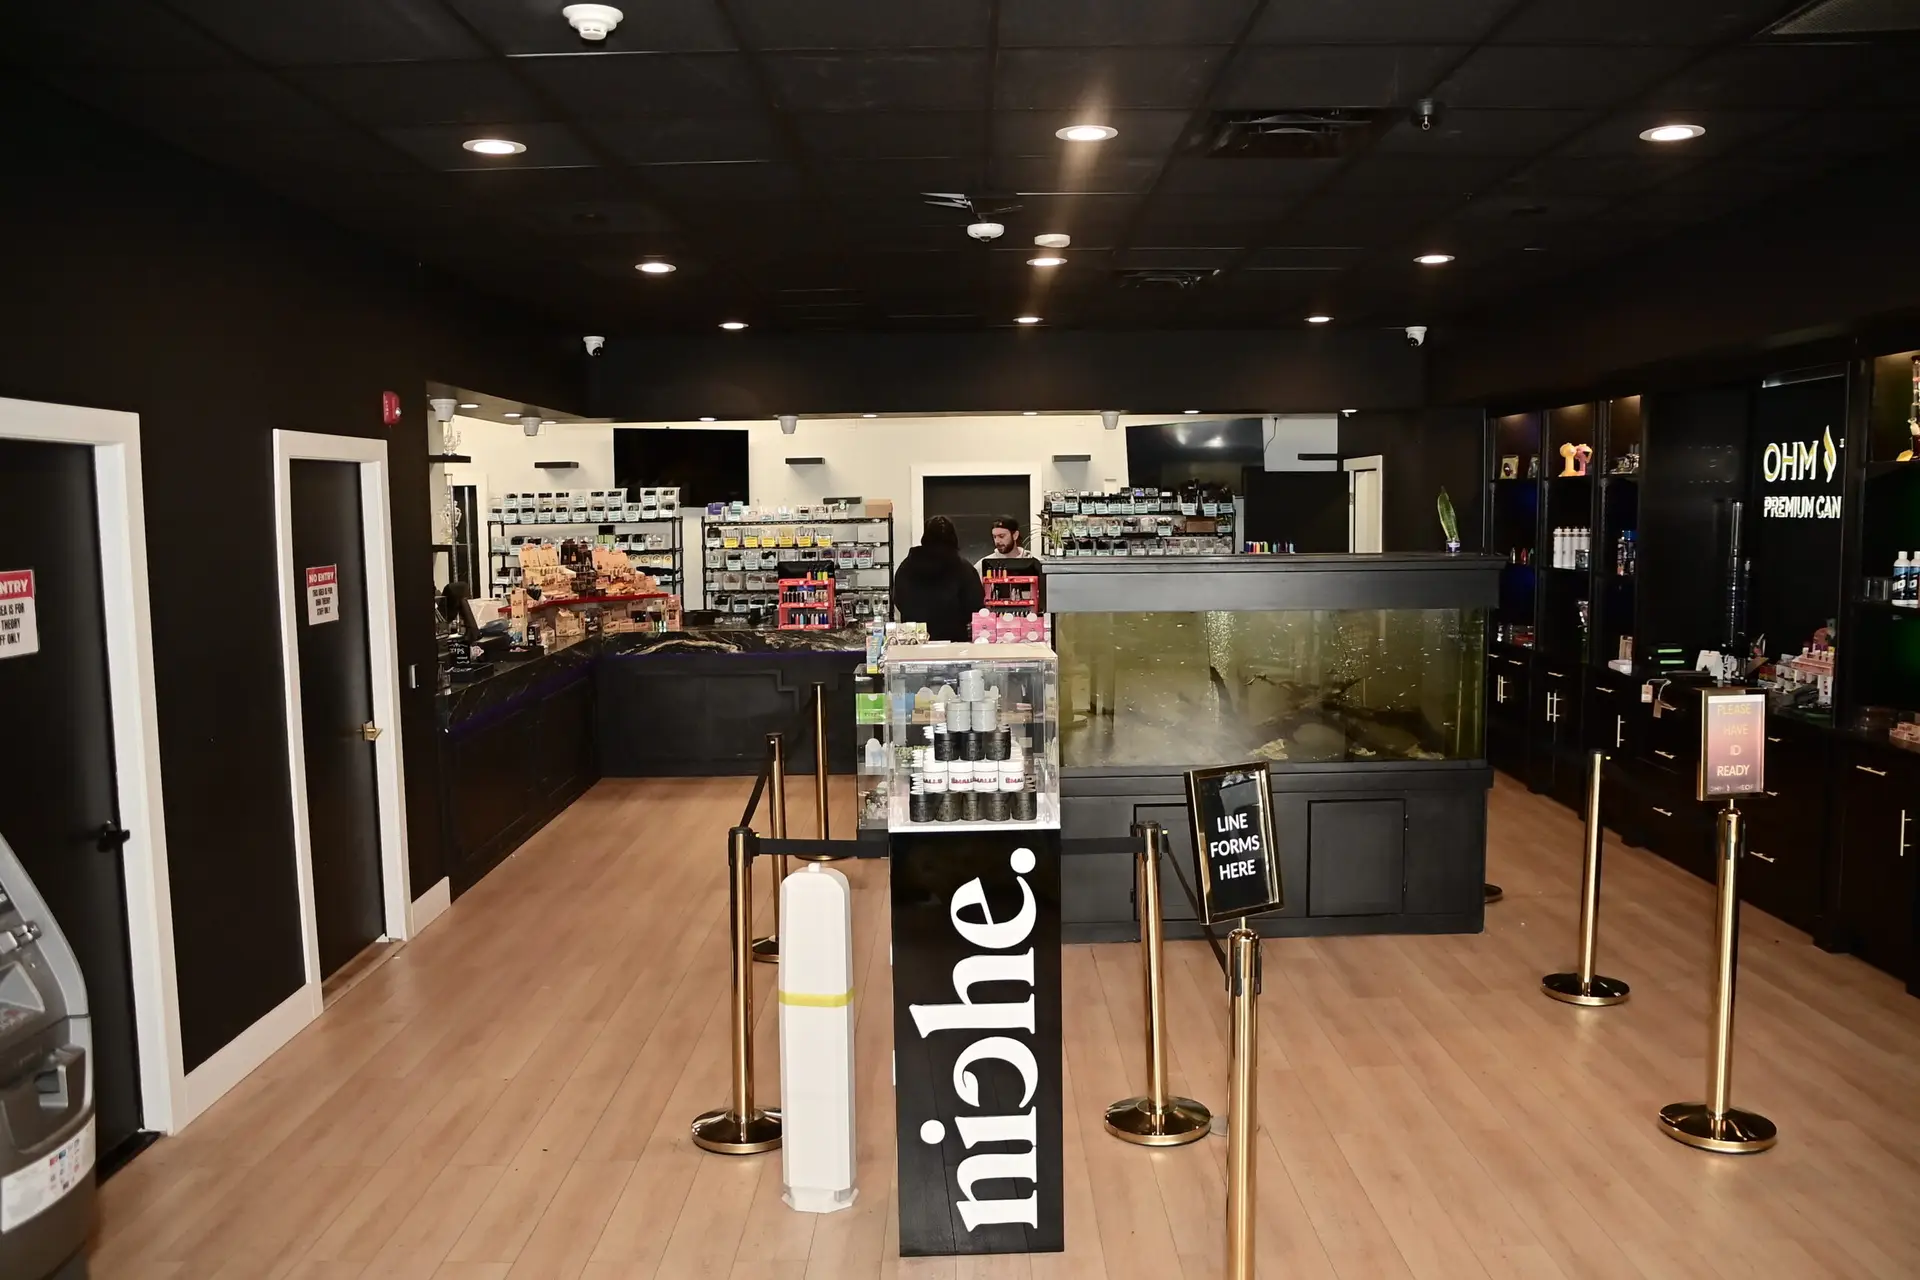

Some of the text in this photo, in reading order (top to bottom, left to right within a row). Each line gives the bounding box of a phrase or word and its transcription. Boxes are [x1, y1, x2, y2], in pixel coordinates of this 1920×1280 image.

[1763, 440, 1819, 483] OHM
[1763, 495, 1815, 518] PREMIUM
[1717, 703, 1752, 716] PLEASE
[1723, 724, 1749, 736] HAVE
[1730, 744, 1741, 756] ID
[1716, 764, 1750, 777] READY
[1216, 812, 1249, 833] LINE
[1210, 834, 1261, 858] FORMS
[1219, 859, 1257, 881] HERE
